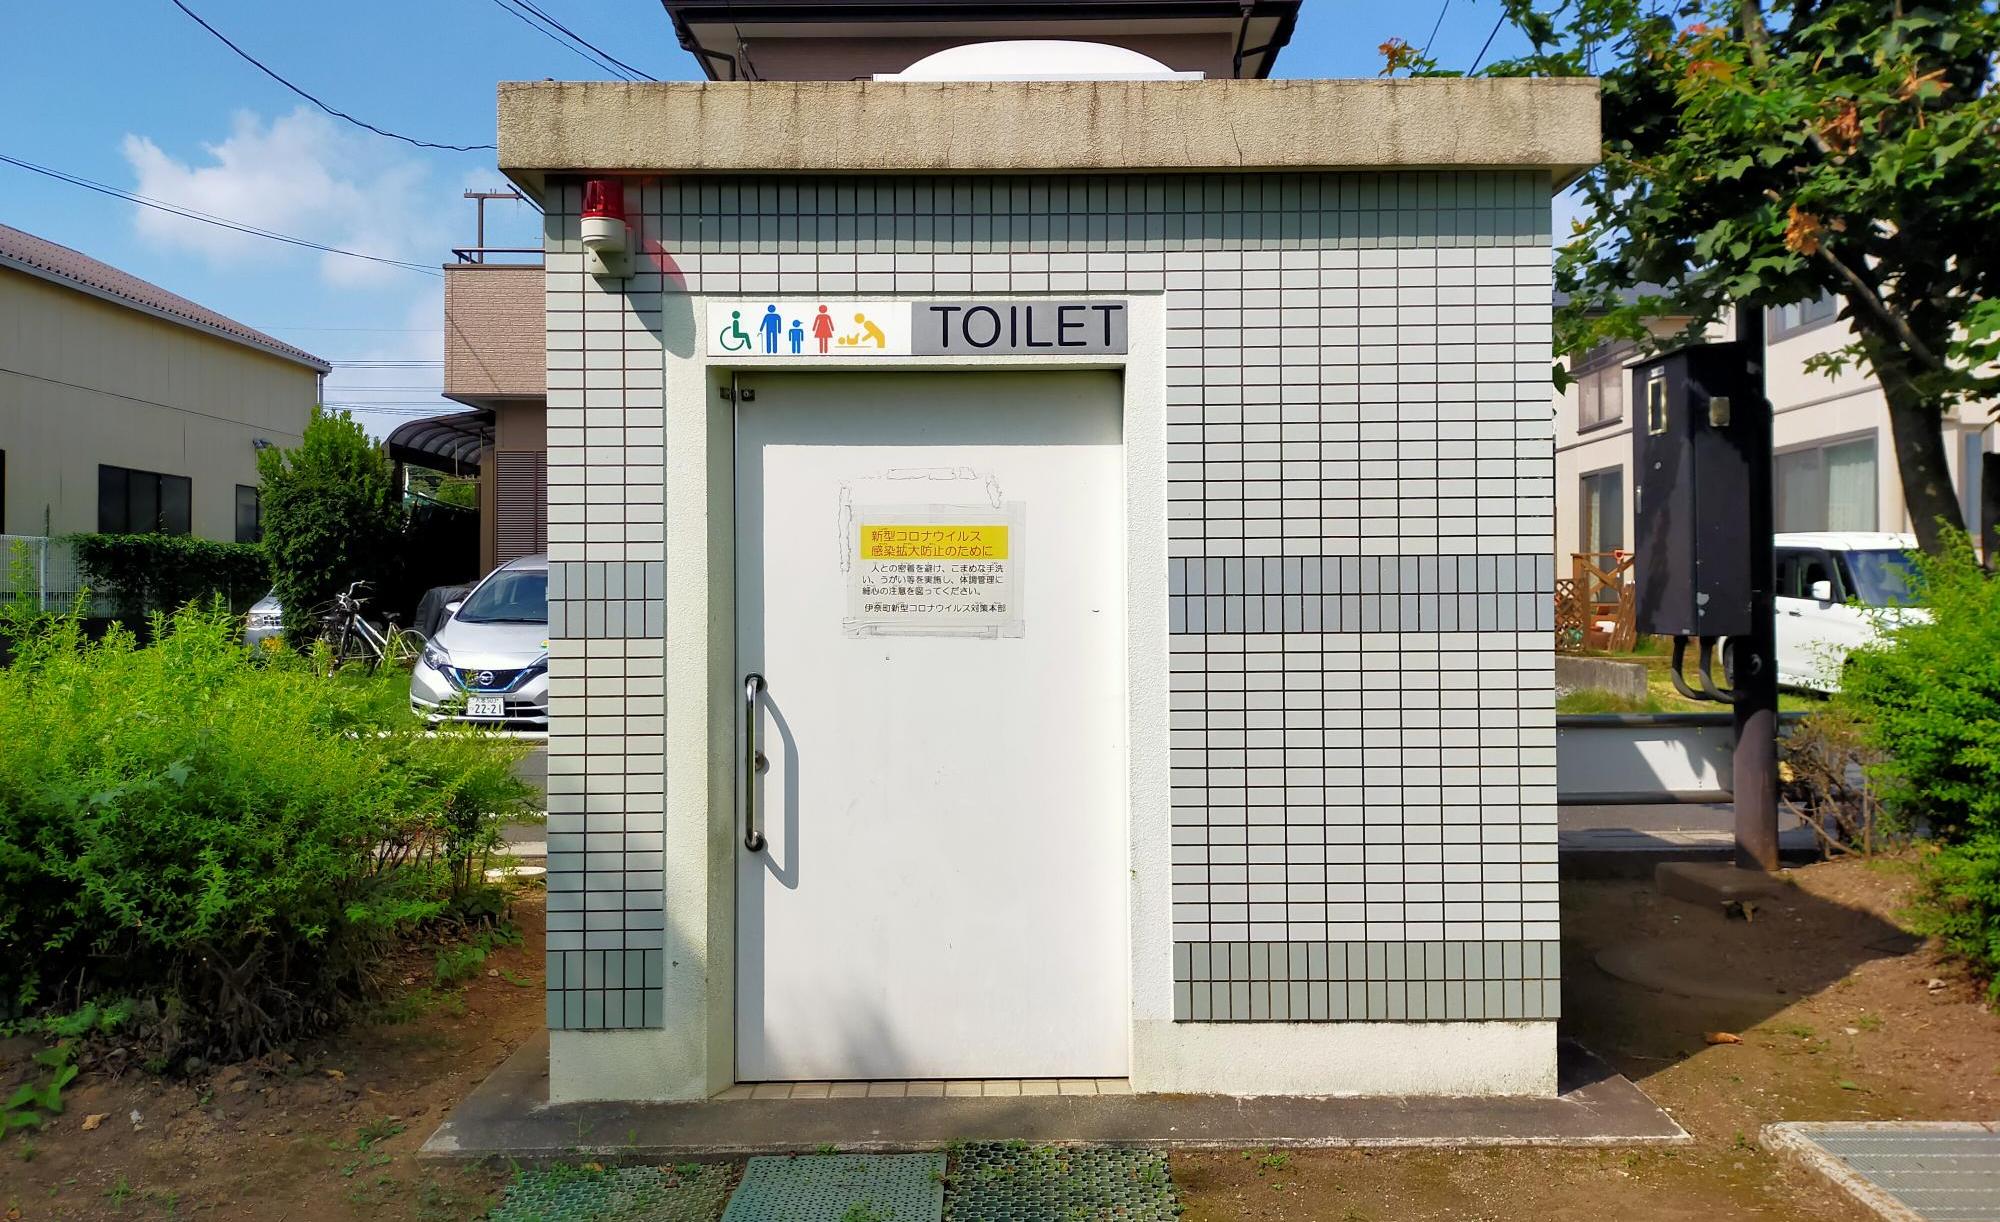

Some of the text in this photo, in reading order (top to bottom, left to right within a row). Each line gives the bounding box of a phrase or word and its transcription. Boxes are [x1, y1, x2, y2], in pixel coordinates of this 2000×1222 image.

[930, 305, 1124, 348] TOILET
[871, 530, 982, 542] 新型コロナウイルス
[871, 544, 993, 557] 感染拡大防止のために
[864, 604, 1007, 613] 伊奈町新型コロナウイルス対策本部
